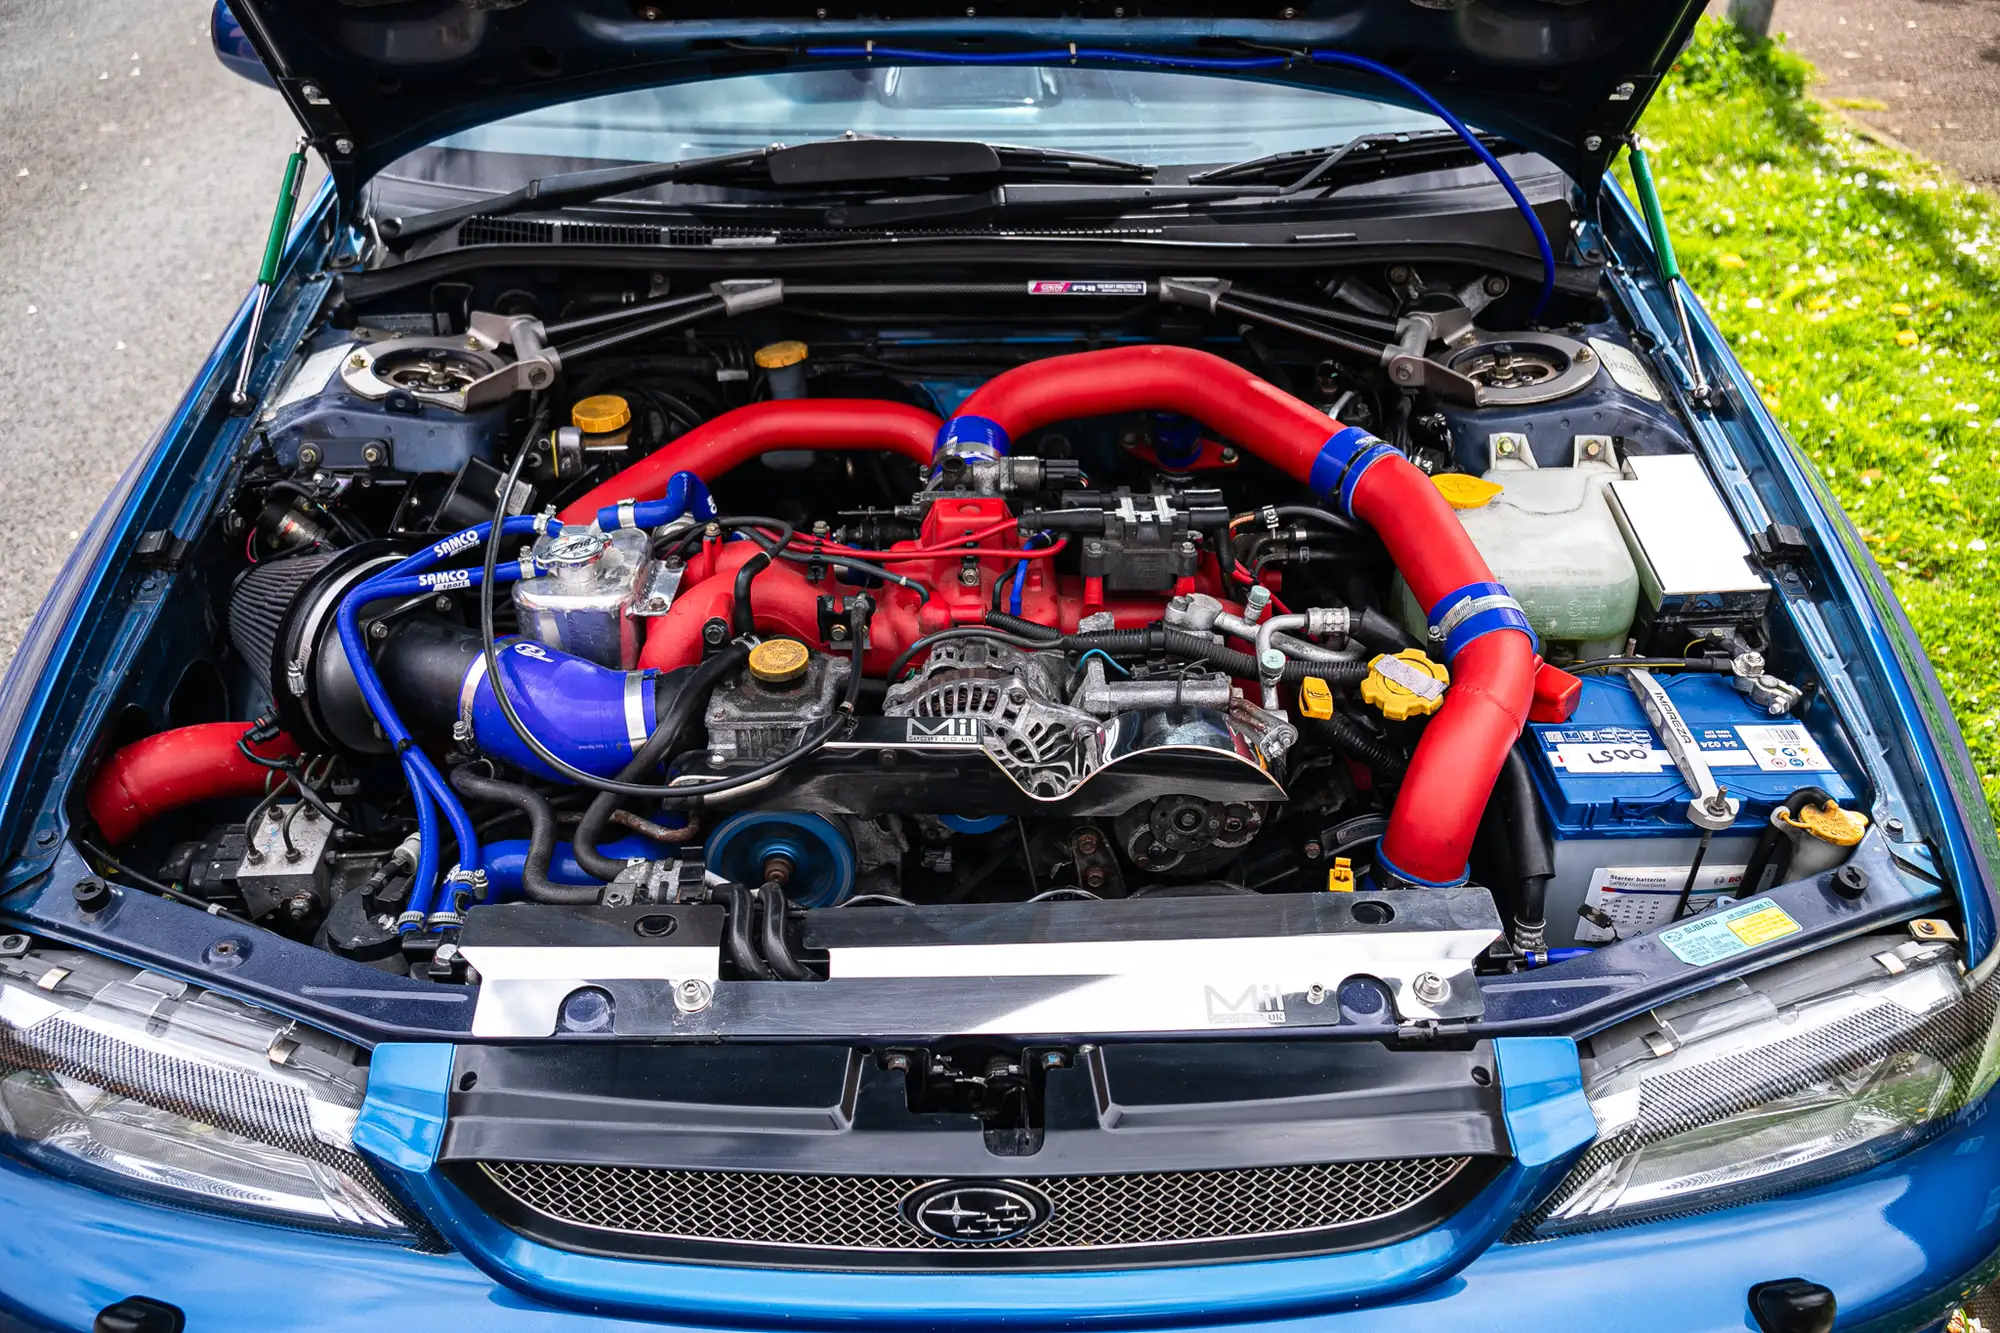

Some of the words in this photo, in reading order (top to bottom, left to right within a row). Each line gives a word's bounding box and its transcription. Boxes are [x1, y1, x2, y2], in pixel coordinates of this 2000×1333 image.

[433, 529, 479, 558] SAMCO
[418, 569, 469, 587] SAMCO
[442, 580, 467, 590] sport
[1654, 691, 1692, 745] IMPREZA
[1683, 918, 1718, 936] SUBARU
